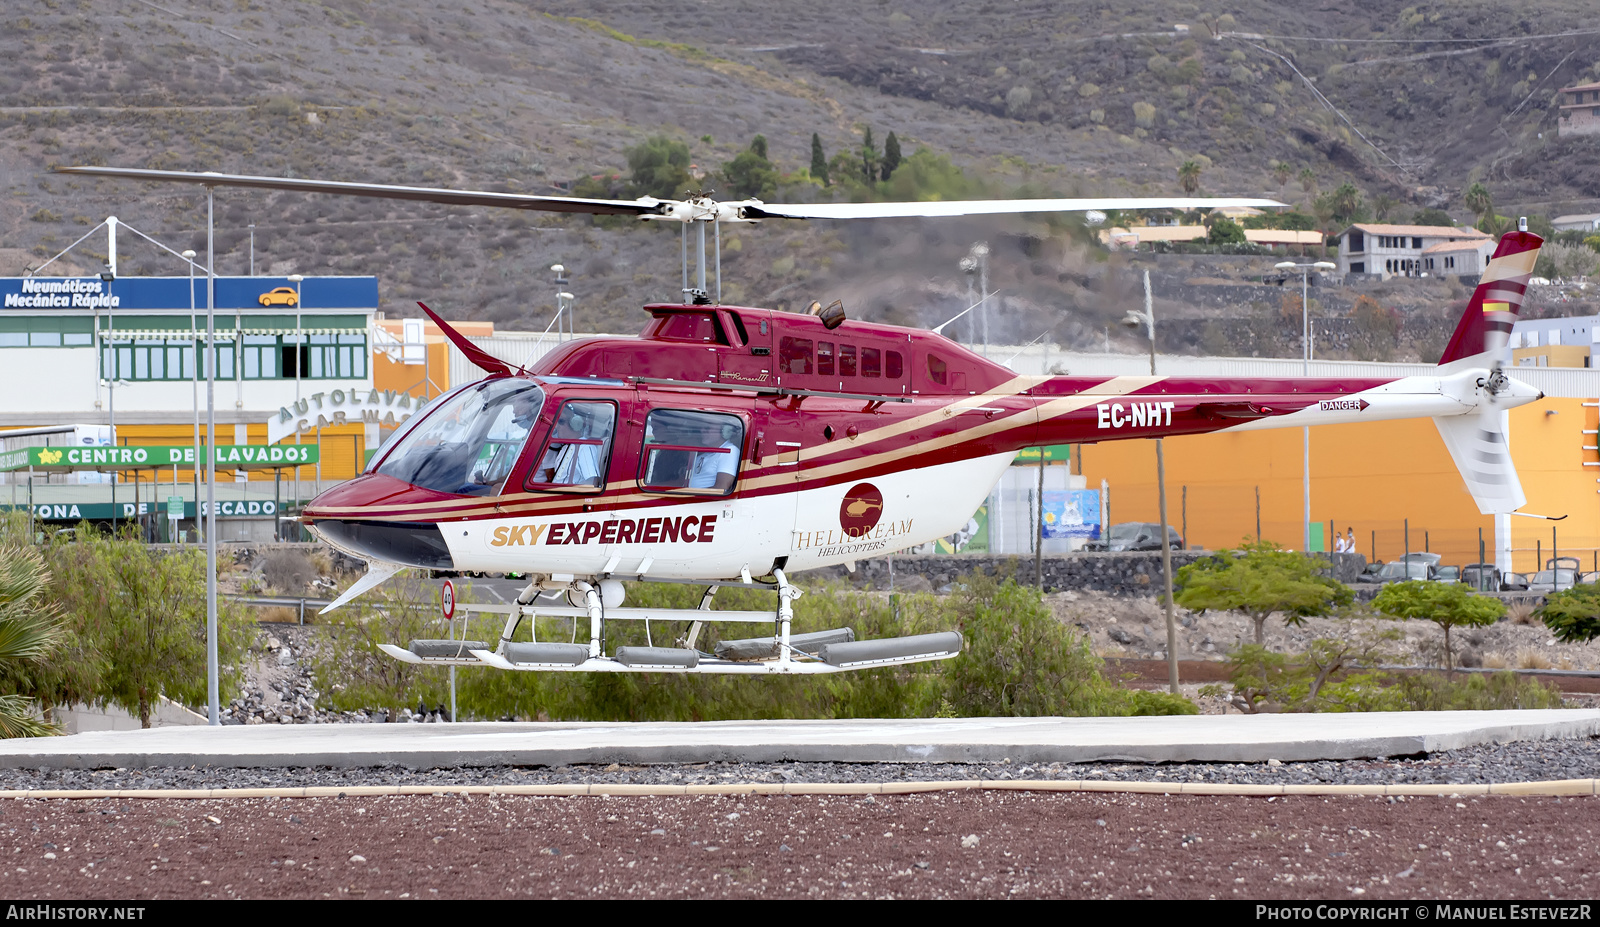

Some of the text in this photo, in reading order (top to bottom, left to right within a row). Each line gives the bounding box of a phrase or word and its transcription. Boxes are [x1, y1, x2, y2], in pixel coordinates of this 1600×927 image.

[22, 279, 102, 293] Neumáticos
[5, 293, 120, 309] Mecánica Rápida
[1320, 401, 1361, 411] DANGER
[297, 411, 347, 434] CAR
[1096, 402, 1175, 429] EC-NHT
[67, 447, 308, 464] CENTRO DE LAVADOS
[123, 503, 148, 517] DE
[490, 514, 718, 547] SKY EXPERIENCE
[797, 518, 914, 549] HELIDREAM
[817, 540, 887, 558] HELICOPTERS
